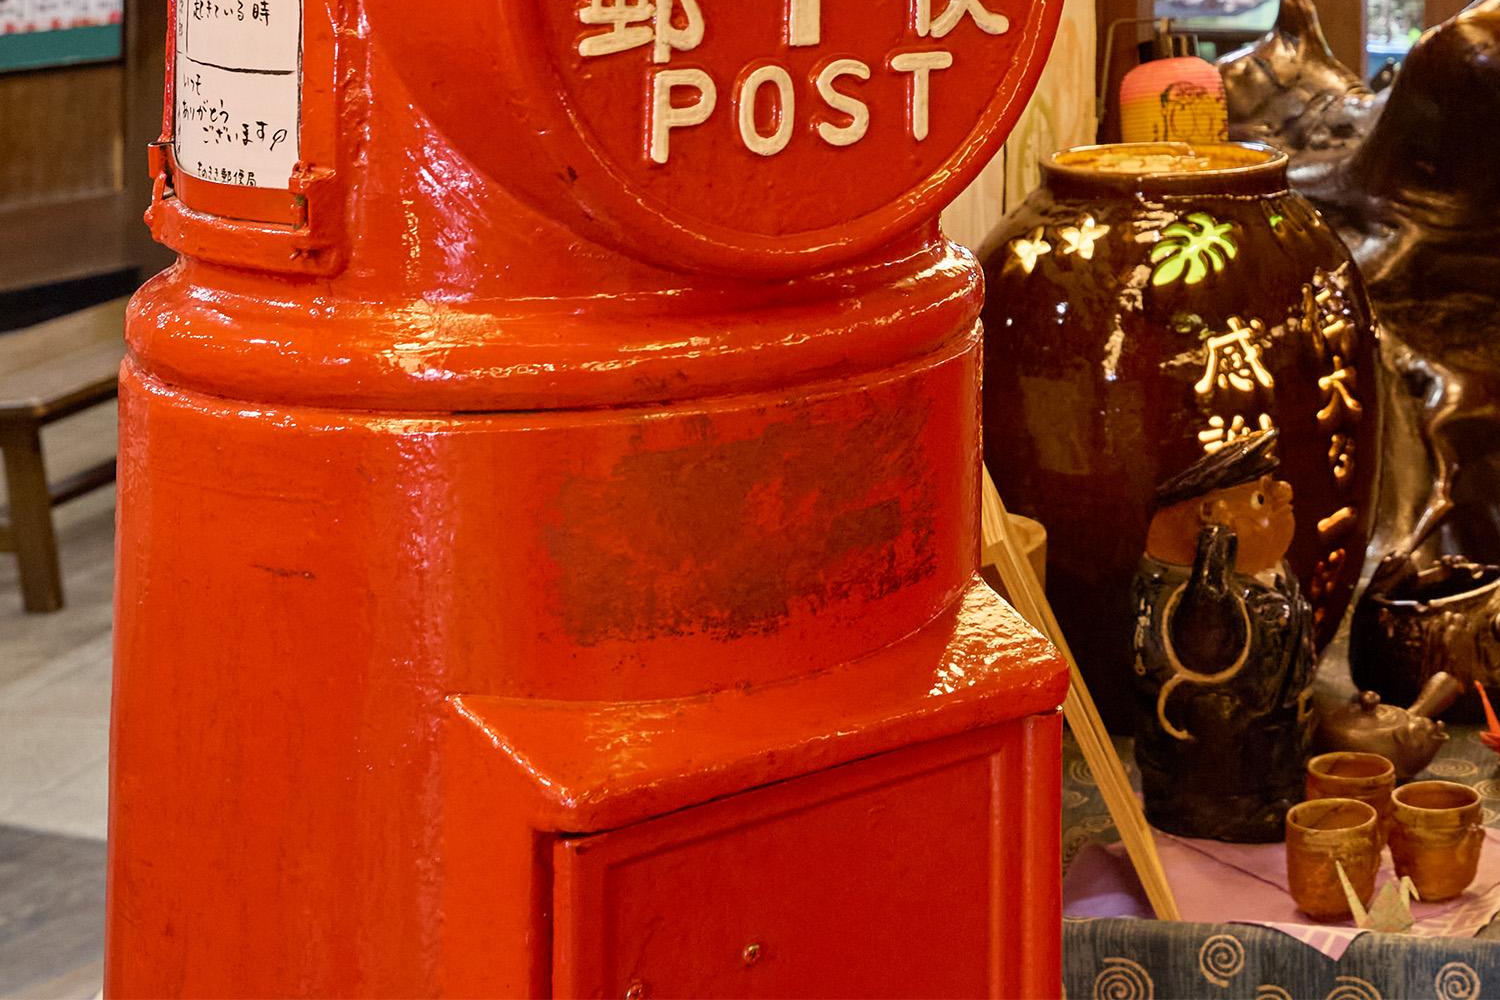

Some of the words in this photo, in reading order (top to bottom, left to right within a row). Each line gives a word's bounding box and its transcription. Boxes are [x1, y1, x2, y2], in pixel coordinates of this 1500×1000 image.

[181, 98, 230, 124] ありがとう
[649, 51, 953, 164] POST
[202, 120, 269, 146] ございます
